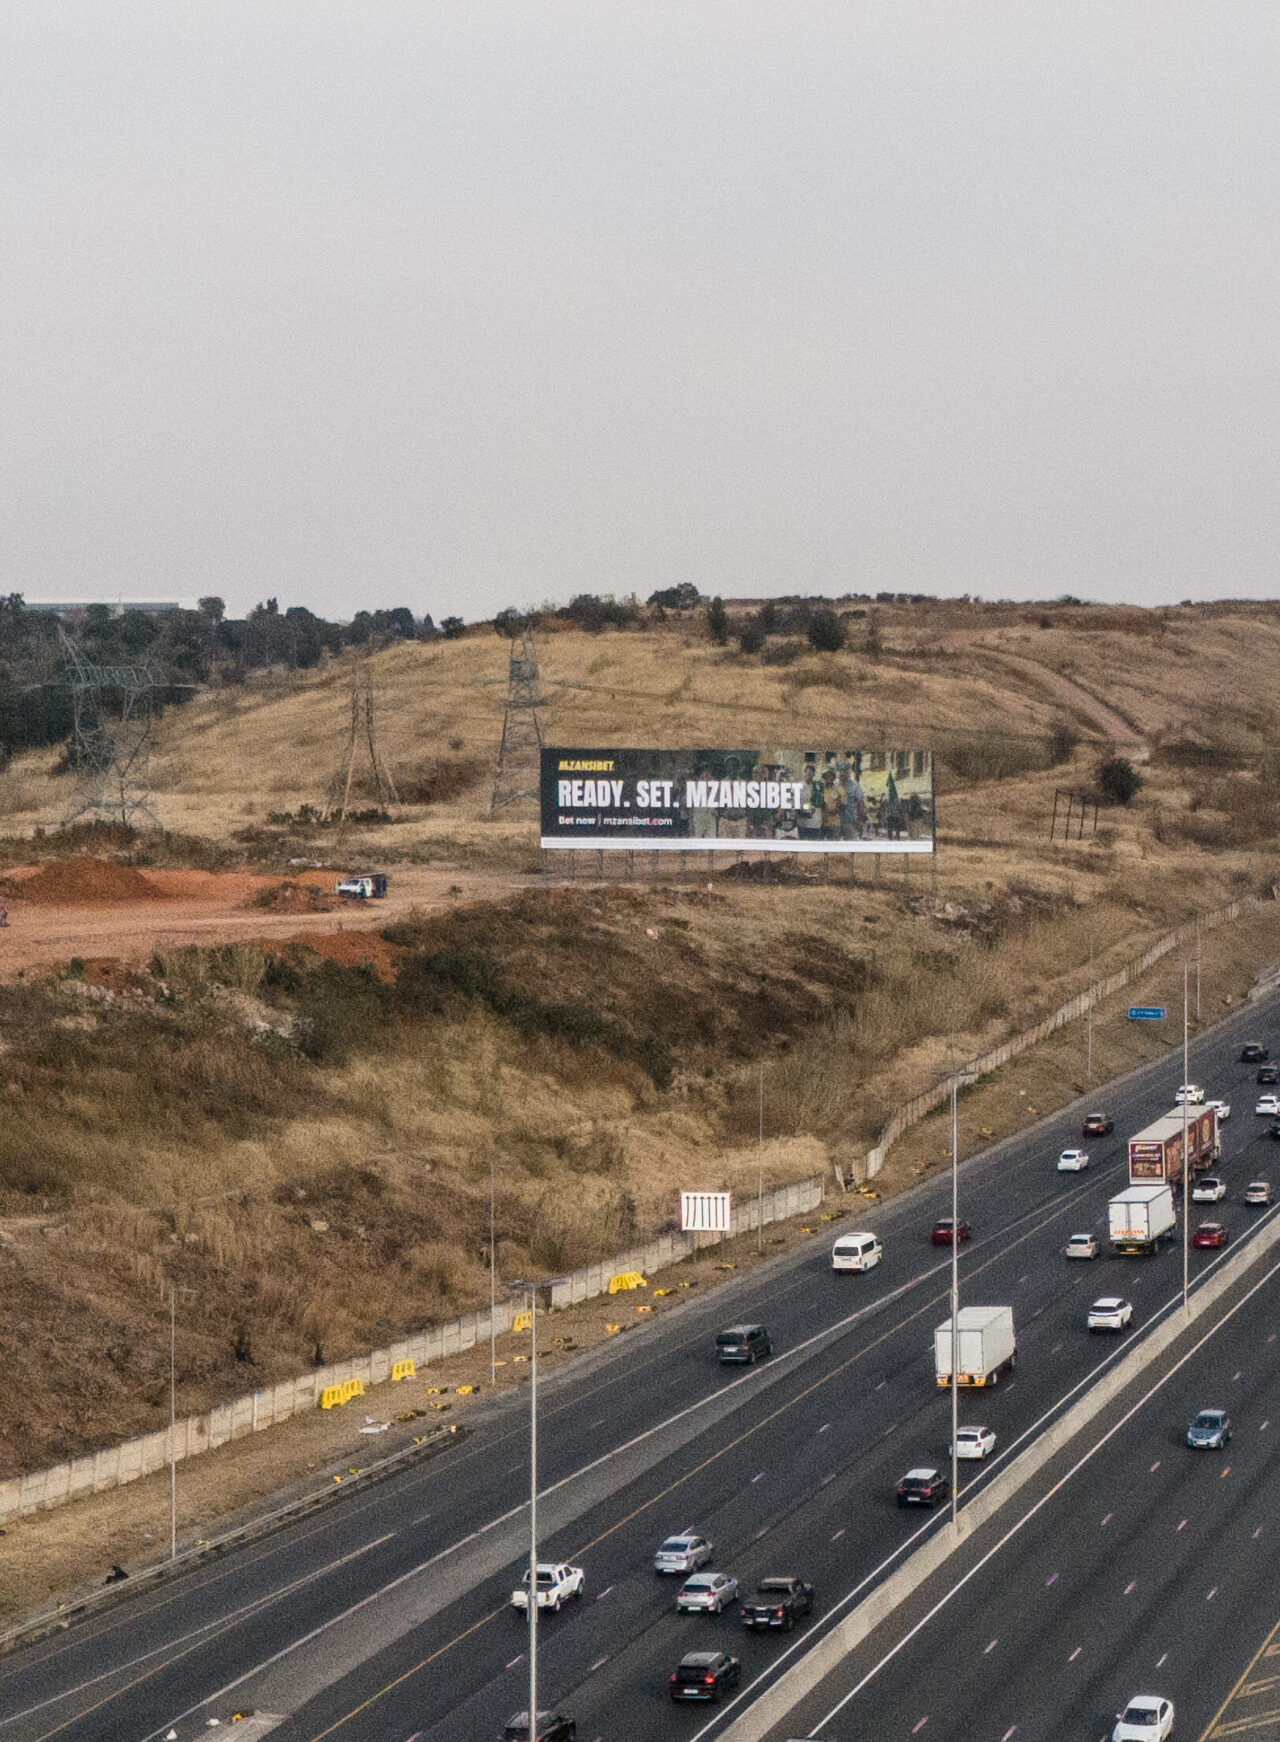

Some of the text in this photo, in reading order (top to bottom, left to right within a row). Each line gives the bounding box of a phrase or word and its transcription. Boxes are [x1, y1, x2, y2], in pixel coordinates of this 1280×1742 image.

[558, 760, 615, 771] MZANSIBET
[558, 780, 810, 810] READY. SET. MZANSIBET.
[559, 816, 673, 826] Bet now mzansibet.com
